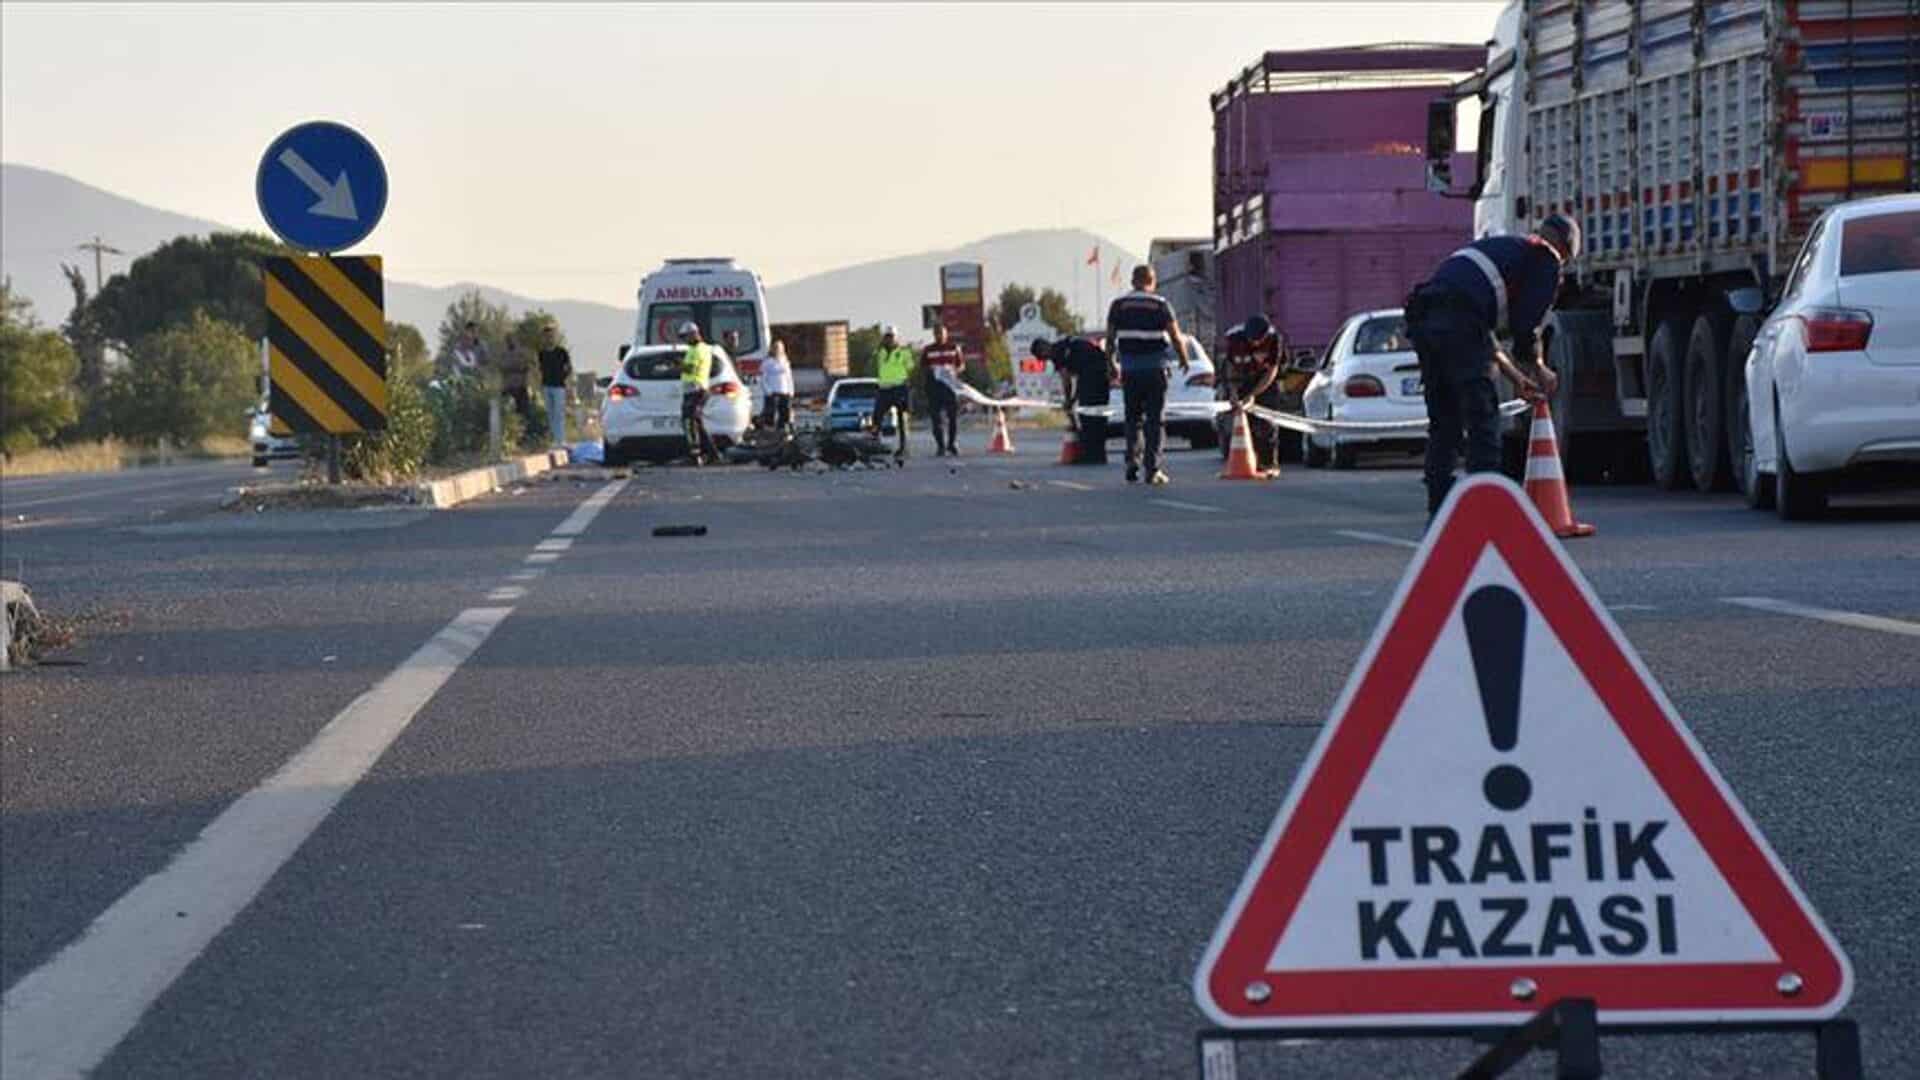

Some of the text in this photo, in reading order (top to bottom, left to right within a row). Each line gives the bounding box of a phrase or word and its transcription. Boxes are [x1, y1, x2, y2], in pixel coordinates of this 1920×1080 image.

[655, 286, 744, 299] AMBULANS
[1351, 806, 1674, 887] TRAFİK
[1357, 895, 1678, 961] KAZASI
